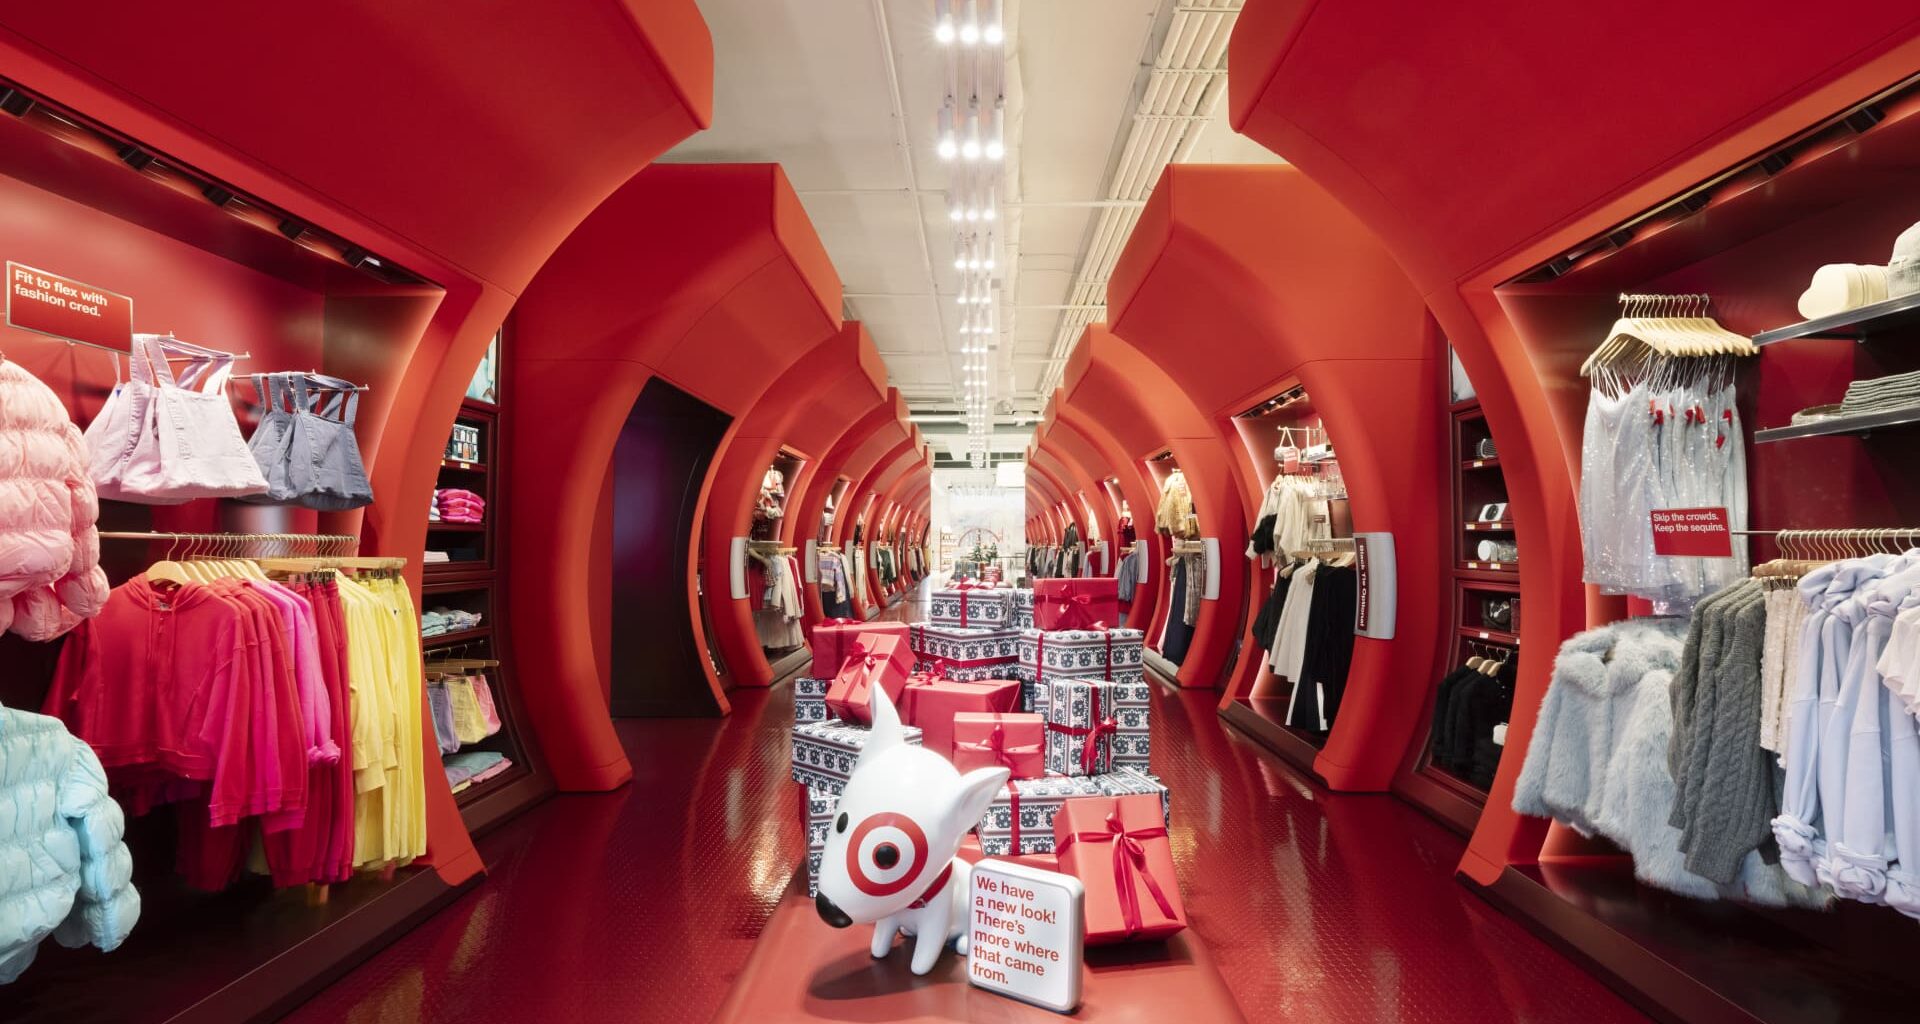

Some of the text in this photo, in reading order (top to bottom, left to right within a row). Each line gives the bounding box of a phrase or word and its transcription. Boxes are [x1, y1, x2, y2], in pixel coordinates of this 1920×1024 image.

[15, 269, 108, 306] Fit to flex with
[15, 284, 101, 317] fashion cred.
[1653, 511, 1719, 523] Skip the crowds.
[1654, 522, 1726, 534] Keep the sequins.
[1359, 588, 1367, 627] Optional
[976, 875, 1034, 901] We have
[975, 896, 1056, 924] a new look!
[975, 910, 1025, 935] There's
[974, 930, 1059, 961] more where
[972, 962, 1009, 984] from.
[973, 945, 1045, 976] that came
